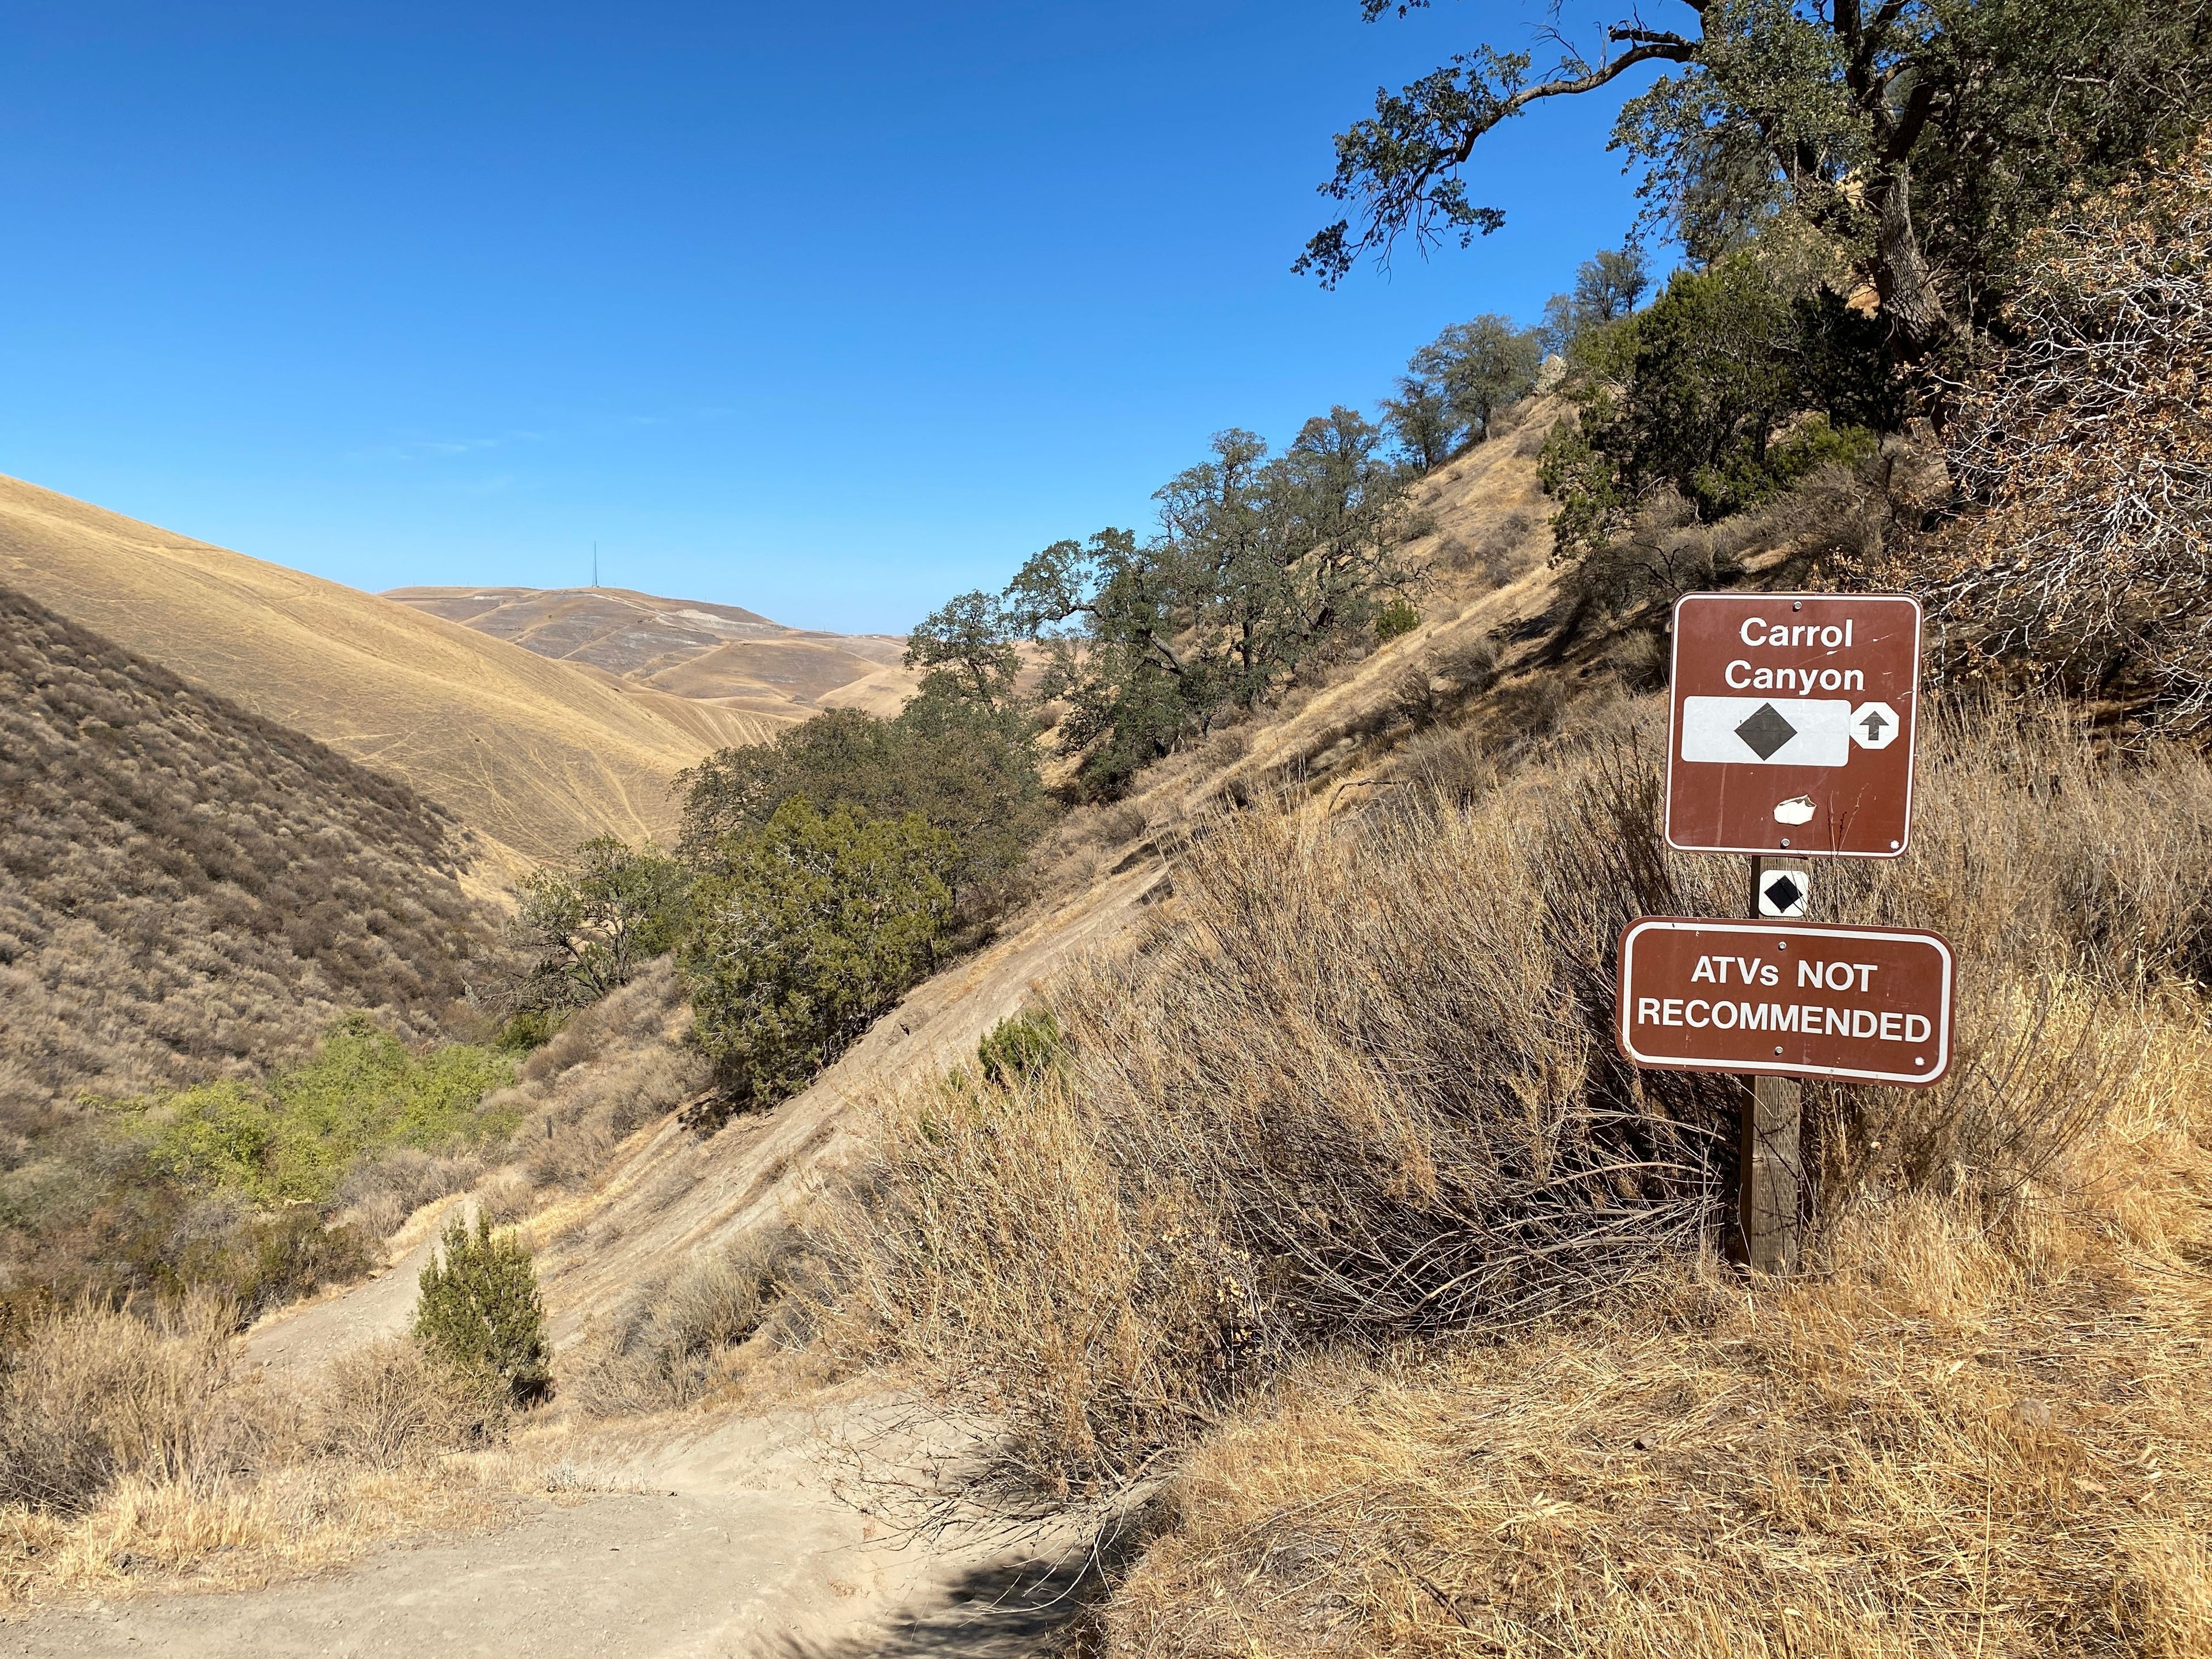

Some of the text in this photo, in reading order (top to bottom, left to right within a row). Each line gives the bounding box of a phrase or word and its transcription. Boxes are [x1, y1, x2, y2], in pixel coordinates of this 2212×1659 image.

[1740, 617, 1853, 647] Carrol
[1725, 660, 1865, 695] Canyon
[1691, 955, 1878, 992] ATVs NOT
[1638, 997, 1931, 1043] RECOMMENDED
